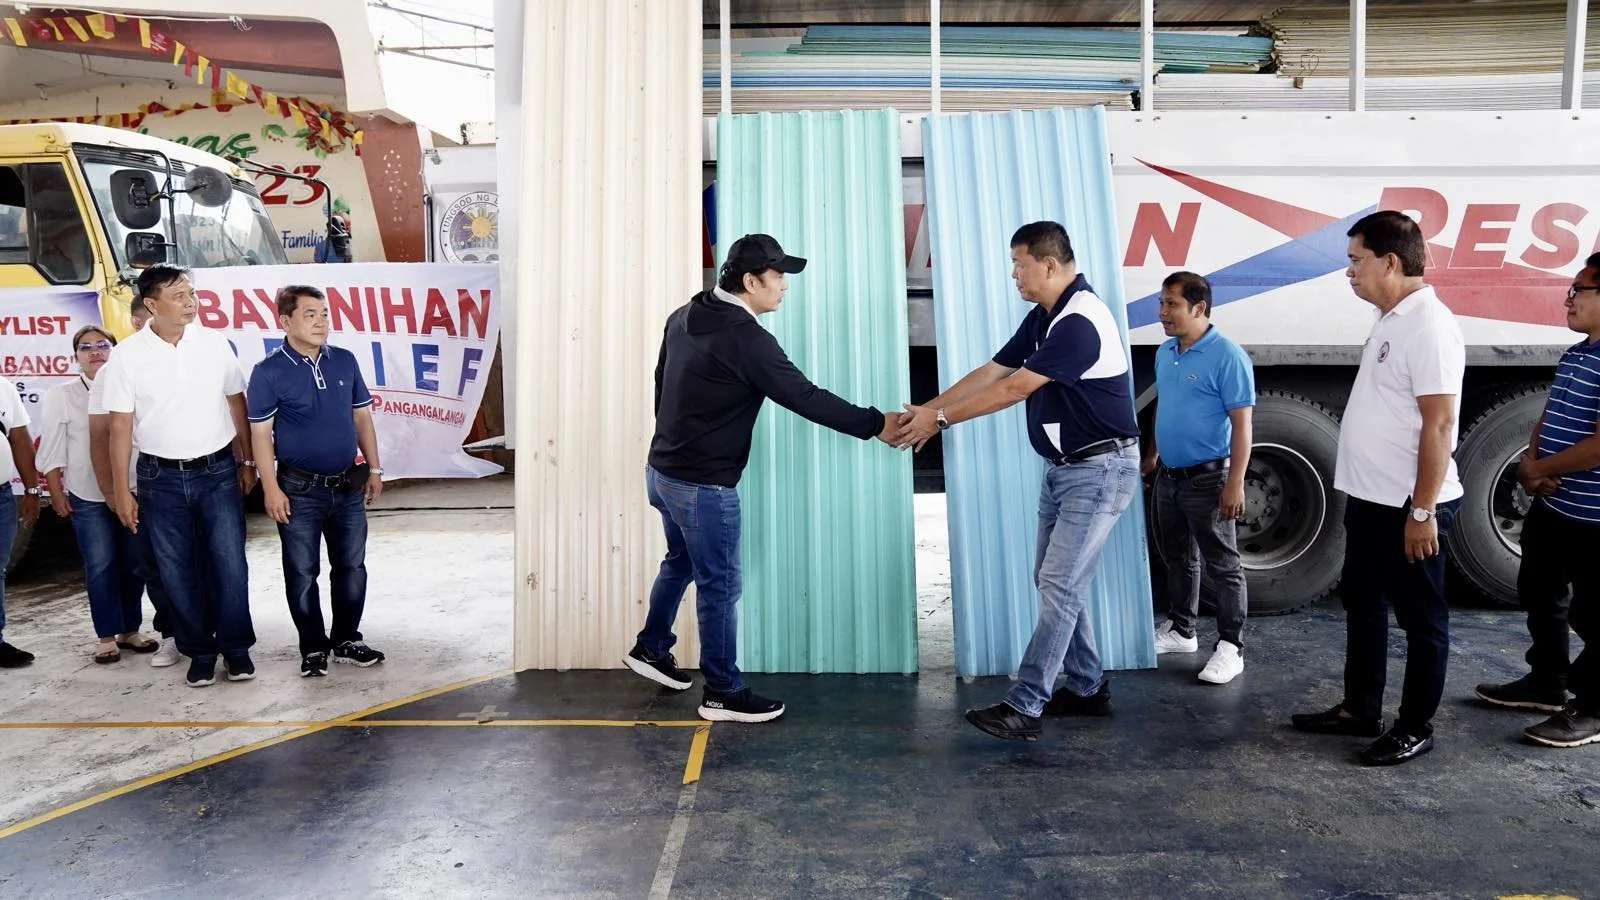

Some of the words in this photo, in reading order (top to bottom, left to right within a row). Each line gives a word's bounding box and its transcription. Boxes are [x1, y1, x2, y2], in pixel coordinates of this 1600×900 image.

[442, 197, 472, 232] LUNGSOD
[476, 194, 490, 202] NG
[1376, 186, 1600, 270] RES
[194, 286, 491, 339] BAYNIHAN
[705, 700, 723, 709] HOKA
